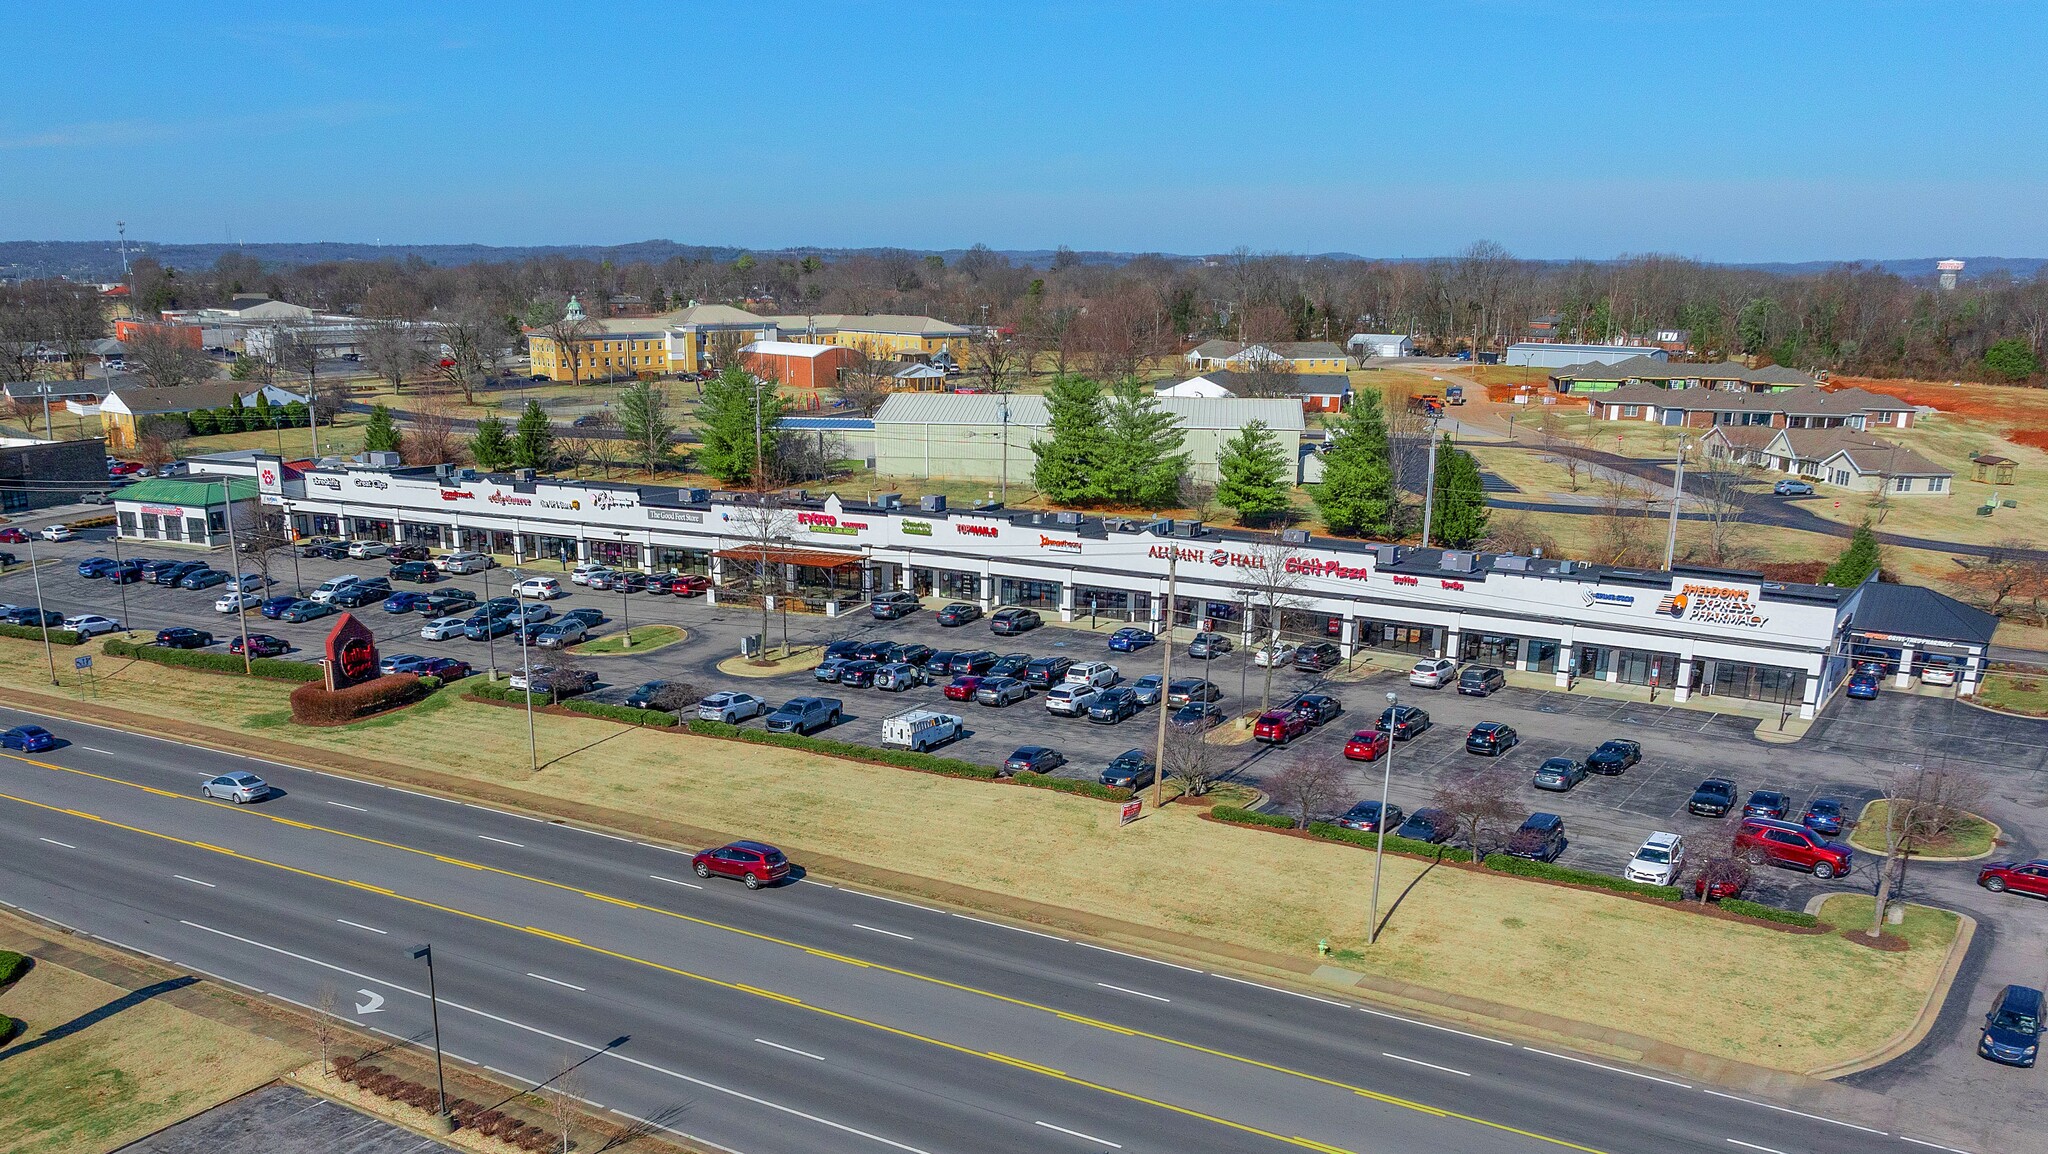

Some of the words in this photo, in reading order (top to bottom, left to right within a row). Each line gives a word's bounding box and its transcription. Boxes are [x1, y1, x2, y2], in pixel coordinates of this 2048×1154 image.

[354, 478, 372, 487] Great
[373, 480, 388, 490] Clips
[650, 511, 660, 519] The
[660, 511, 674, 520] Good
[675, 513, 686, 521] Feet
[685, 513, 700, 522] Store
[798, 513, 837, 526] KYOTO
[1230, 553, 1266, 569] HALL
[1393, 576, 1418, 586] Buffet
[1682, 584, 1750, 601] SHELDON'S
[1693, 599, 1756, 615] EXPRESS
[1690, 610, 1769, 628] PHARMACY
